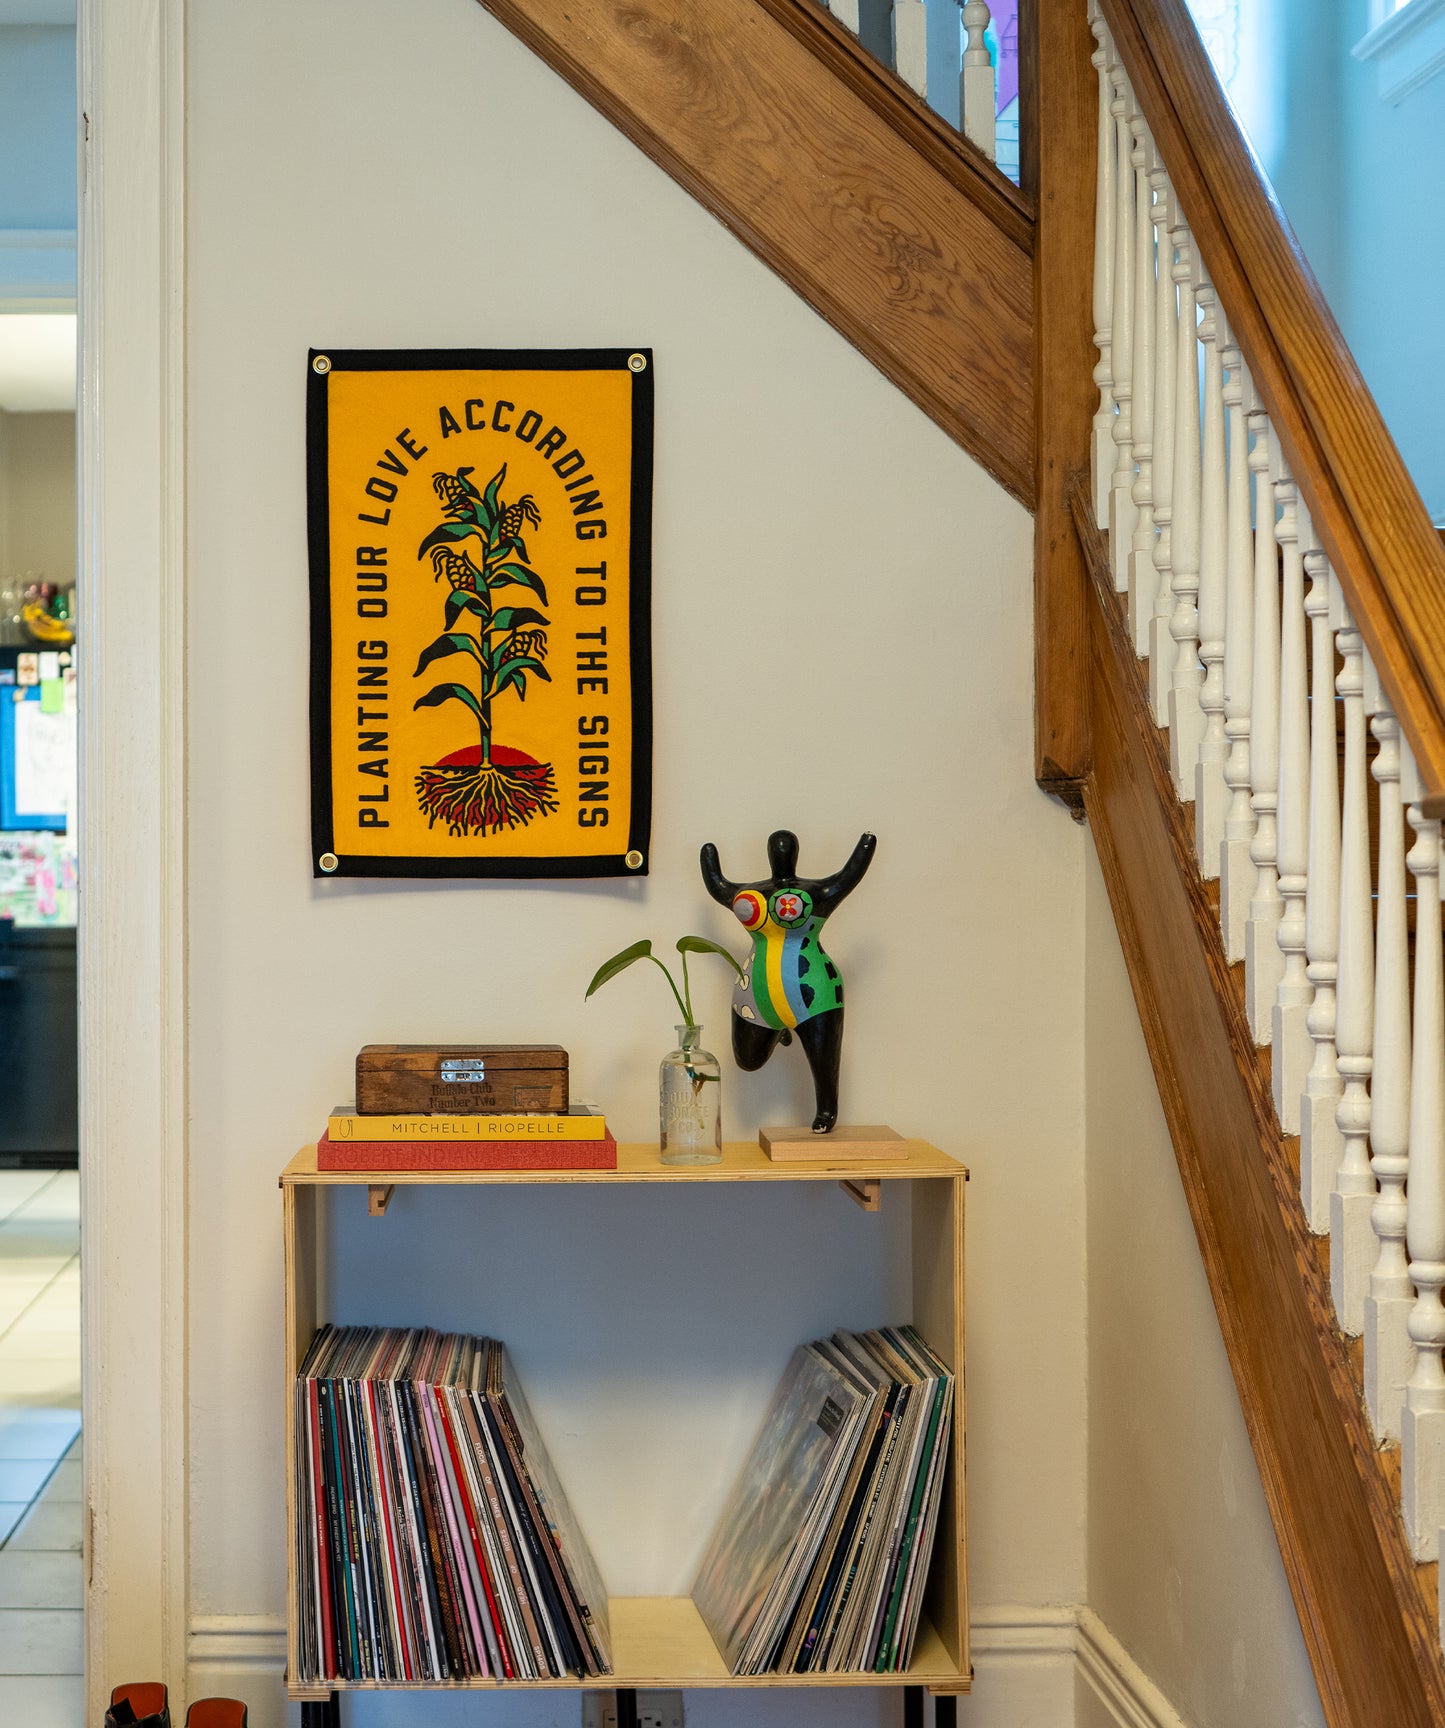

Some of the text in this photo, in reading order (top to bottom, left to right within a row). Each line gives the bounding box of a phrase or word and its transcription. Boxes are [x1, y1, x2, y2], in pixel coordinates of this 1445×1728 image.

[356, 398, 609, 828] PLANTING OUR LOVE ACCORDING TO THE SIGNS
[429, 1096, 496, 1109] Number Two
[432, 1082, 493, 1097] Buffalo Club
[392, 1123, 469, 1134] MITCHELL
[488, 1122, 566, 1134] RIOPELLE
[474, 1442, 501, 1518] FLOCK OF DIMES
[499, 1528, 527, 1604] HEAD OF ROSES
